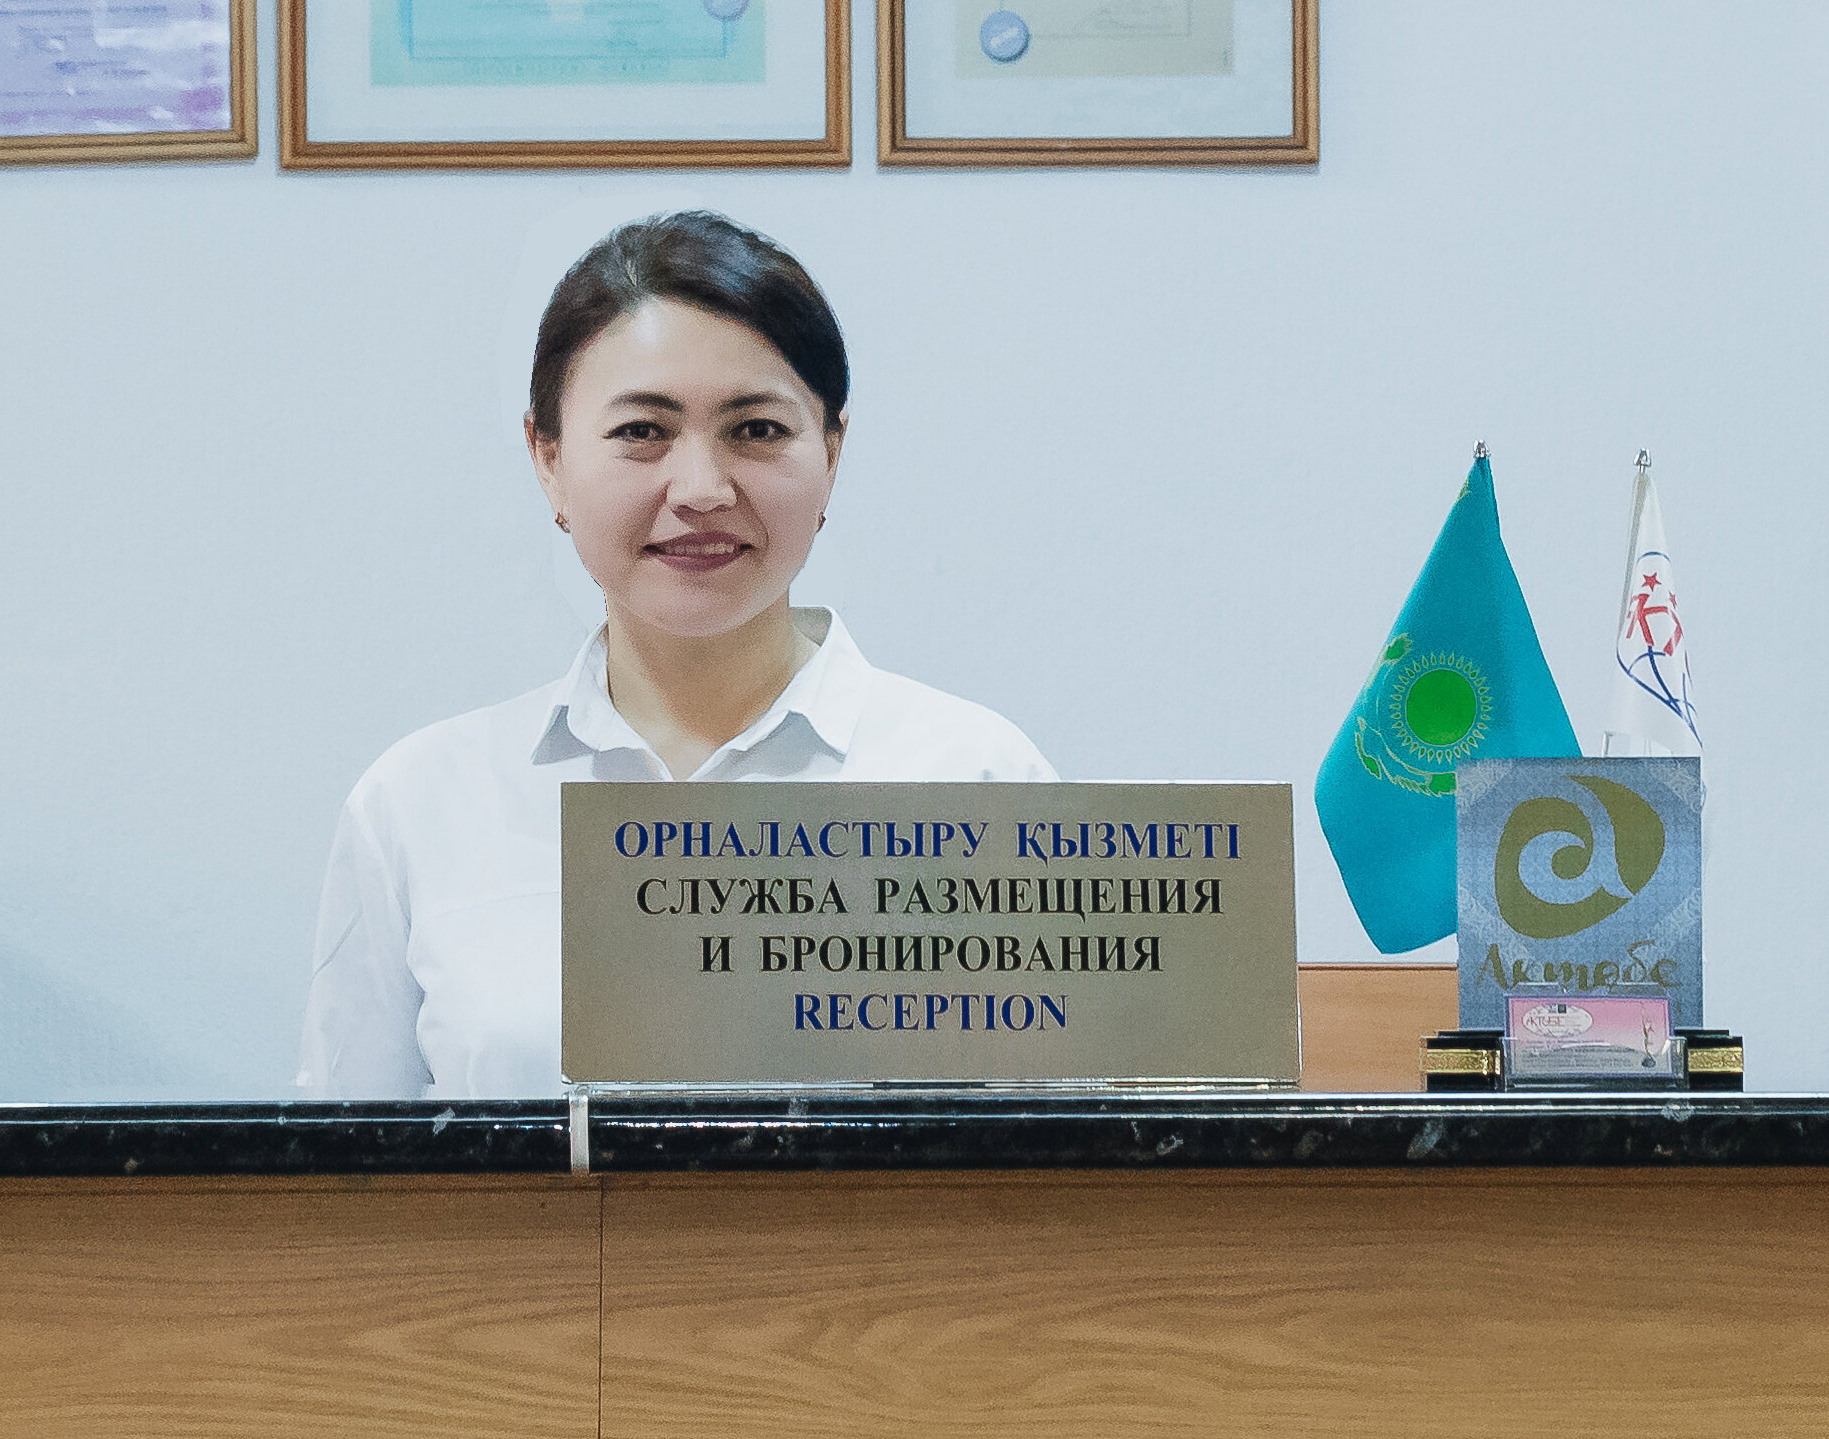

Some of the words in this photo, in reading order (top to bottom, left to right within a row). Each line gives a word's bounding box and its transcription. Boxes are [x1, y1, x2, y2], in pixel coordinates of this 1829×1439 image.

[614, 820, 990, 860] ОРНАЛАСТЫРУ
[1016, 820, 1241, 867] ҚЫЗМЕТІ
[636, 877, 848, 915] СЛУЖБА
[875, 877, 1224, 921] РАЗМЕЩЕНИЯ
[700, 935, 734, 973] И
[760, 935, 1164, 973] БРОНИРОВАНИЯ
[793, 993, 1070, 1032] RECEPTION
